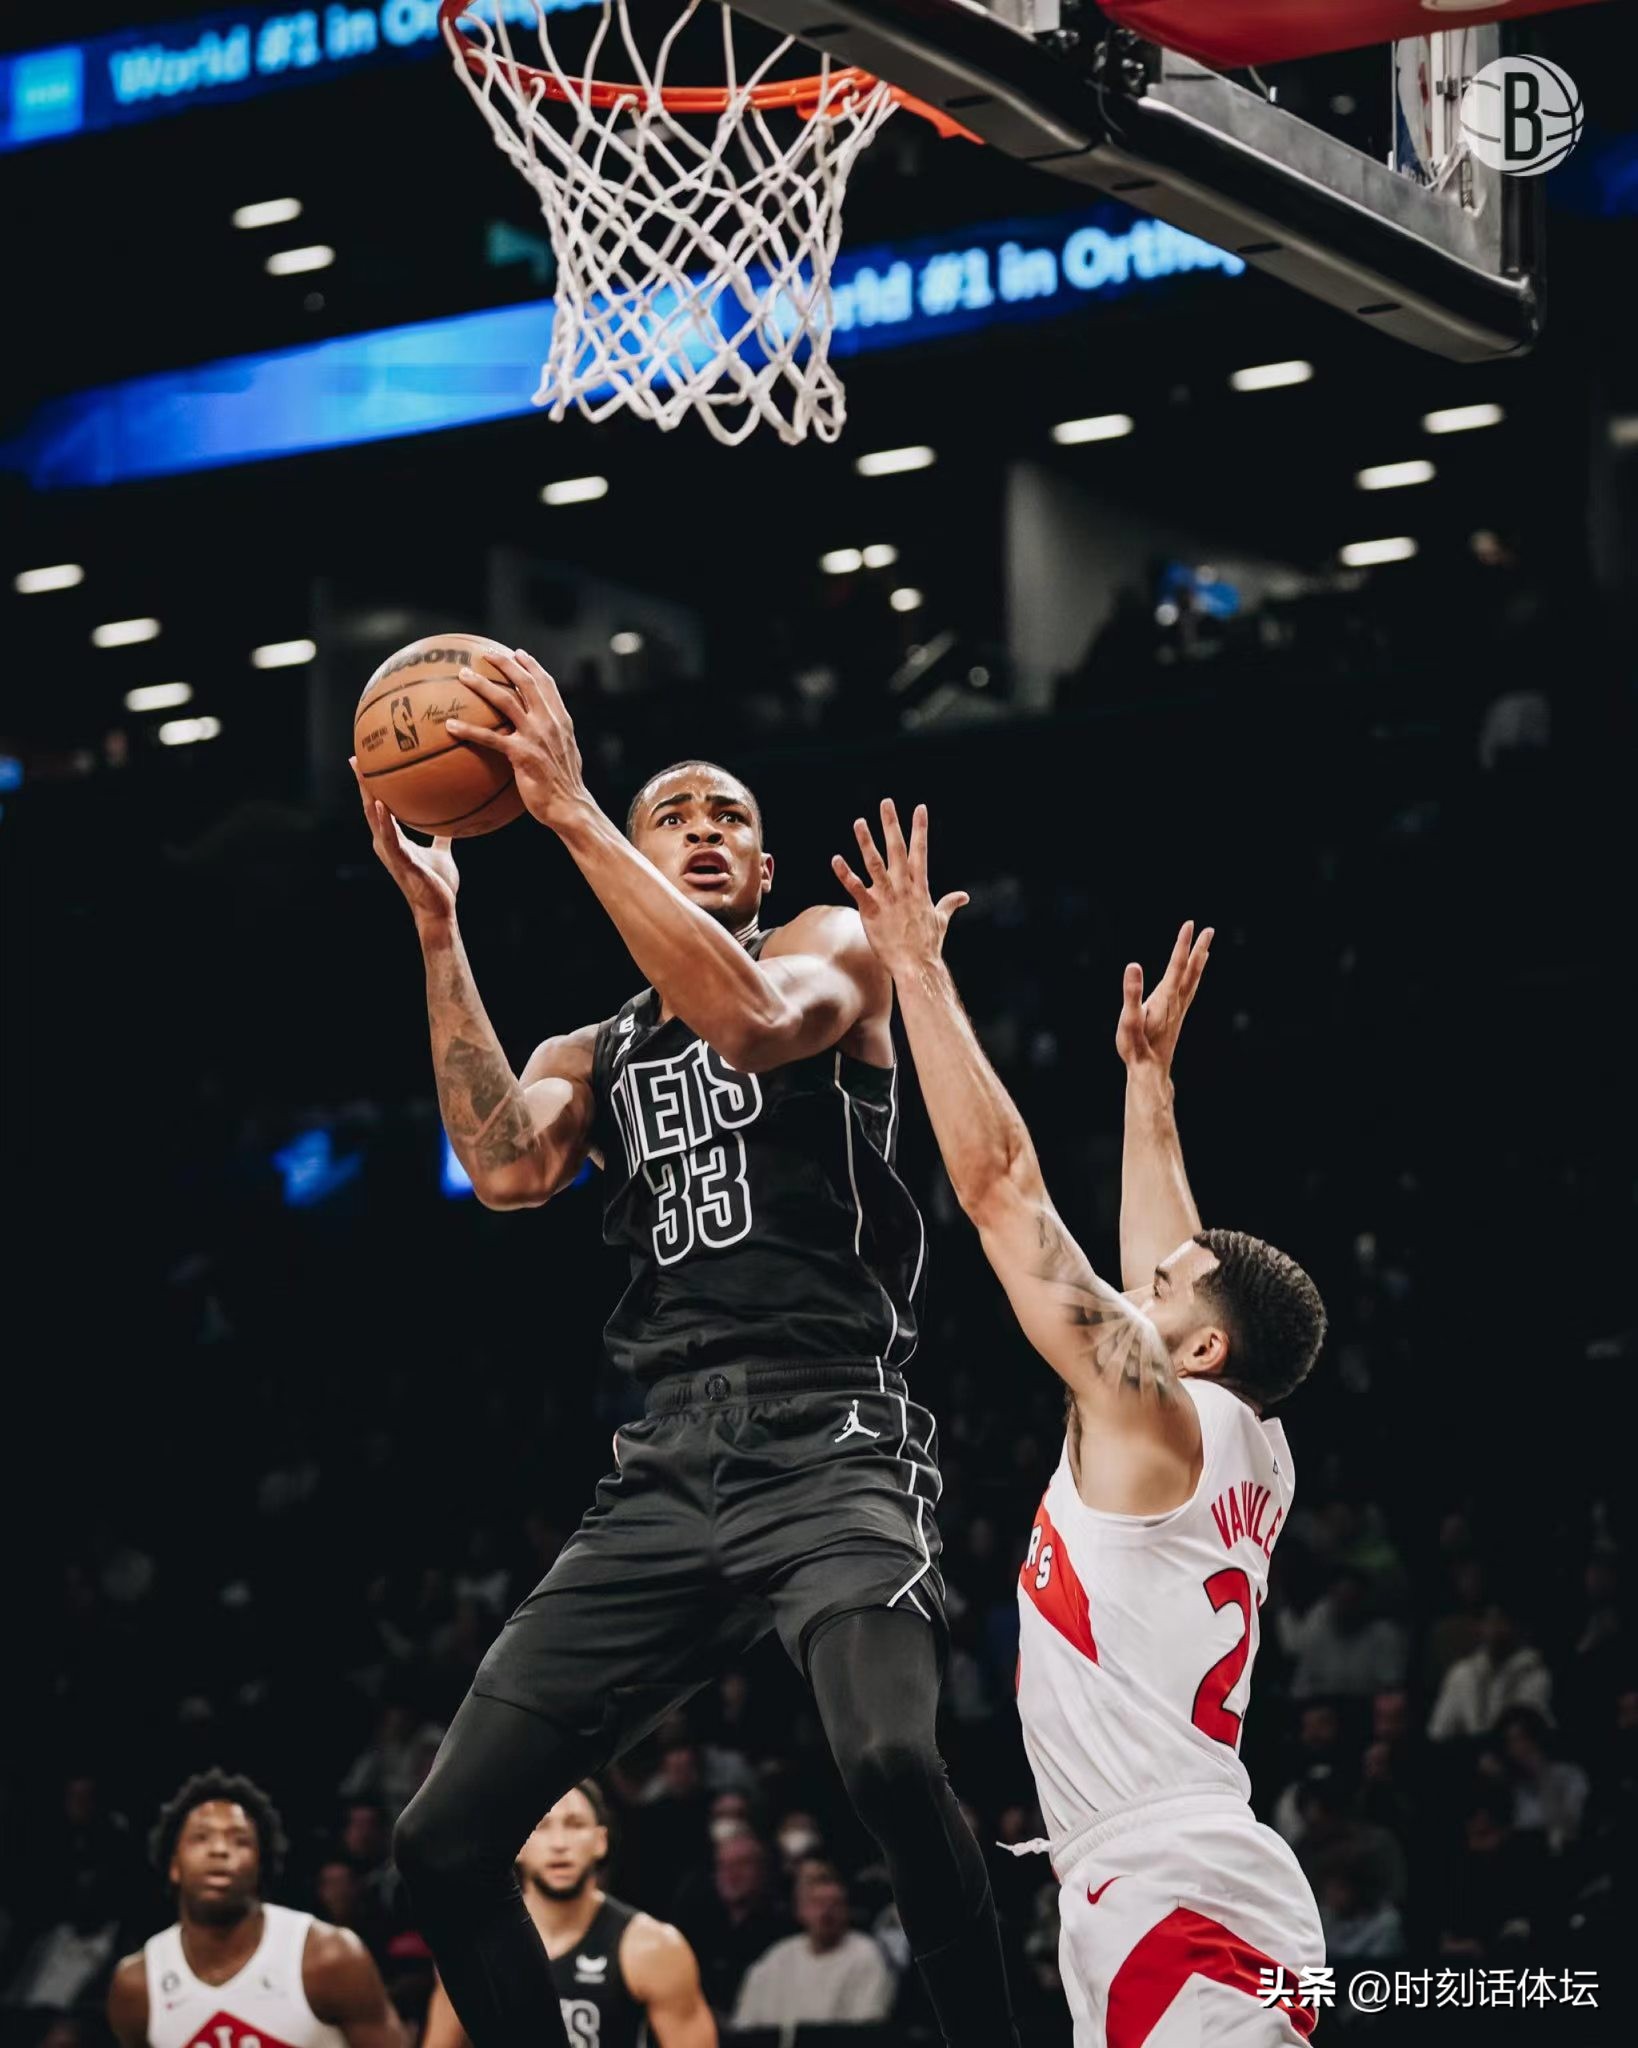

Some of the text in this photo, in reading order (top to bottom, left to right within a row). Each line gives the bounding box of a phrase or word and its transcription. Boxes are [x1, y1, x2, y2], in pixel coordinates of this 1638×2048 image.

[109, 26, 250, 104] World
[257, 9, 318, 74] #1
[324, 4, 378, 60] in
[919, 246, 994, 316] #1
[999, 241, 1057, 301] in
[642, 1130, 753, 1267] 33
[1190, 1566, 1262, 1751] 2
